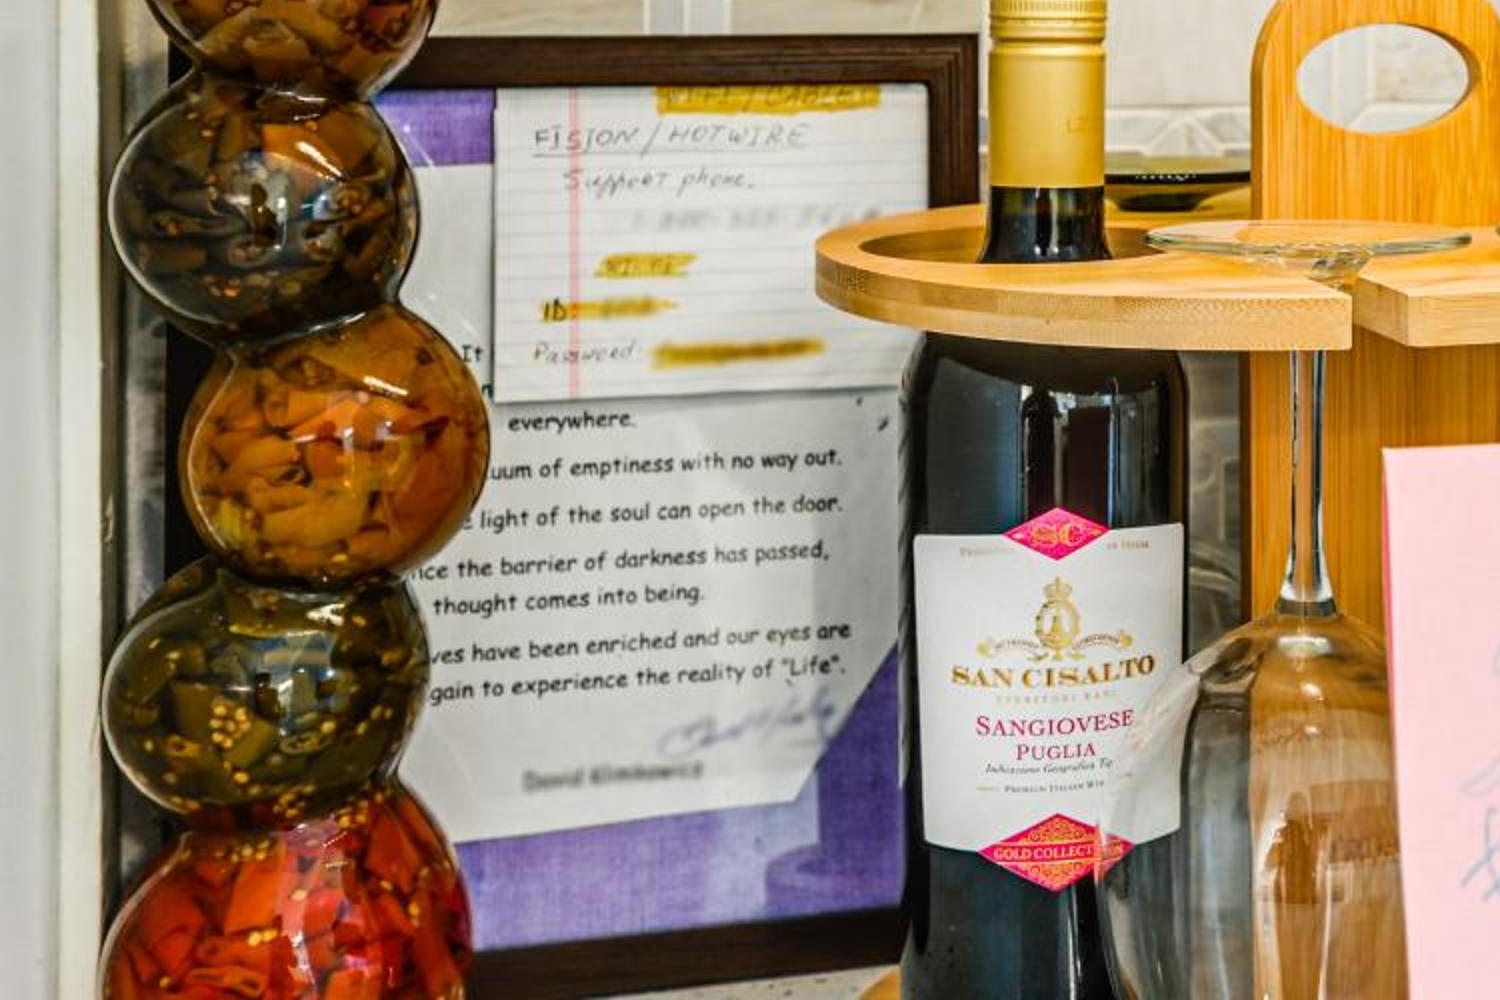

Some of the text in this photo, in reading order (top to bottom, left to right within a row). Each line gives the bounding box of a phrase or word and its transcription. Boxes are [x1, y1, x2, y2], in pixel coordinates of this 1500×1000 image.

[462, 344, 483, 363] It
[490, 449, 843, 482] uum of emptiness with no way out.
[480, 509, 530, 535] light
[536, 505, 560, 527] of
[569, 505, 603, 525] the
[610, 502, 651, 522] soul
[657, 503, 692, 521] can
[697, 502, 745, 525] open
[752, 495, 786, 515] the
[792, 494, 843, 514] door.
[457, 558, 494, 579] the
[500, 556, 578, 577] barrier
[584, 551, 609, 572] of
[614, 548, 708, 570] darkness
[714, 546, 749, 563] has
[755, 540, 830, 567] passed,
[432, 584, 704, 619] thought comes into being.
[471, 641, 522, 662] have
[528, 639, 580, 659] been
[585, 631, 677, 654] enriched
[683, 627, 720, 649] and
[726, 629, 760, 645] our
[766, 625, 812, 647] eyes
[816, 623, 852, 641] are
[430, 682, 475, 707] gain
[483, 680, 505, 698] to
[511, 672, 629, 700] experience
[636, 667, 671, 686] the
[677, 663, 746, 686] reality
[752, 657, 775, 679] of
[951, 655, 1156, 689] SAN CISALTO
[976, 708, 1135, 738] SANGIOVESE
[1016, 743, 1097, 761] PUGLIA
[993, 847, 1032, 860] GOLD
